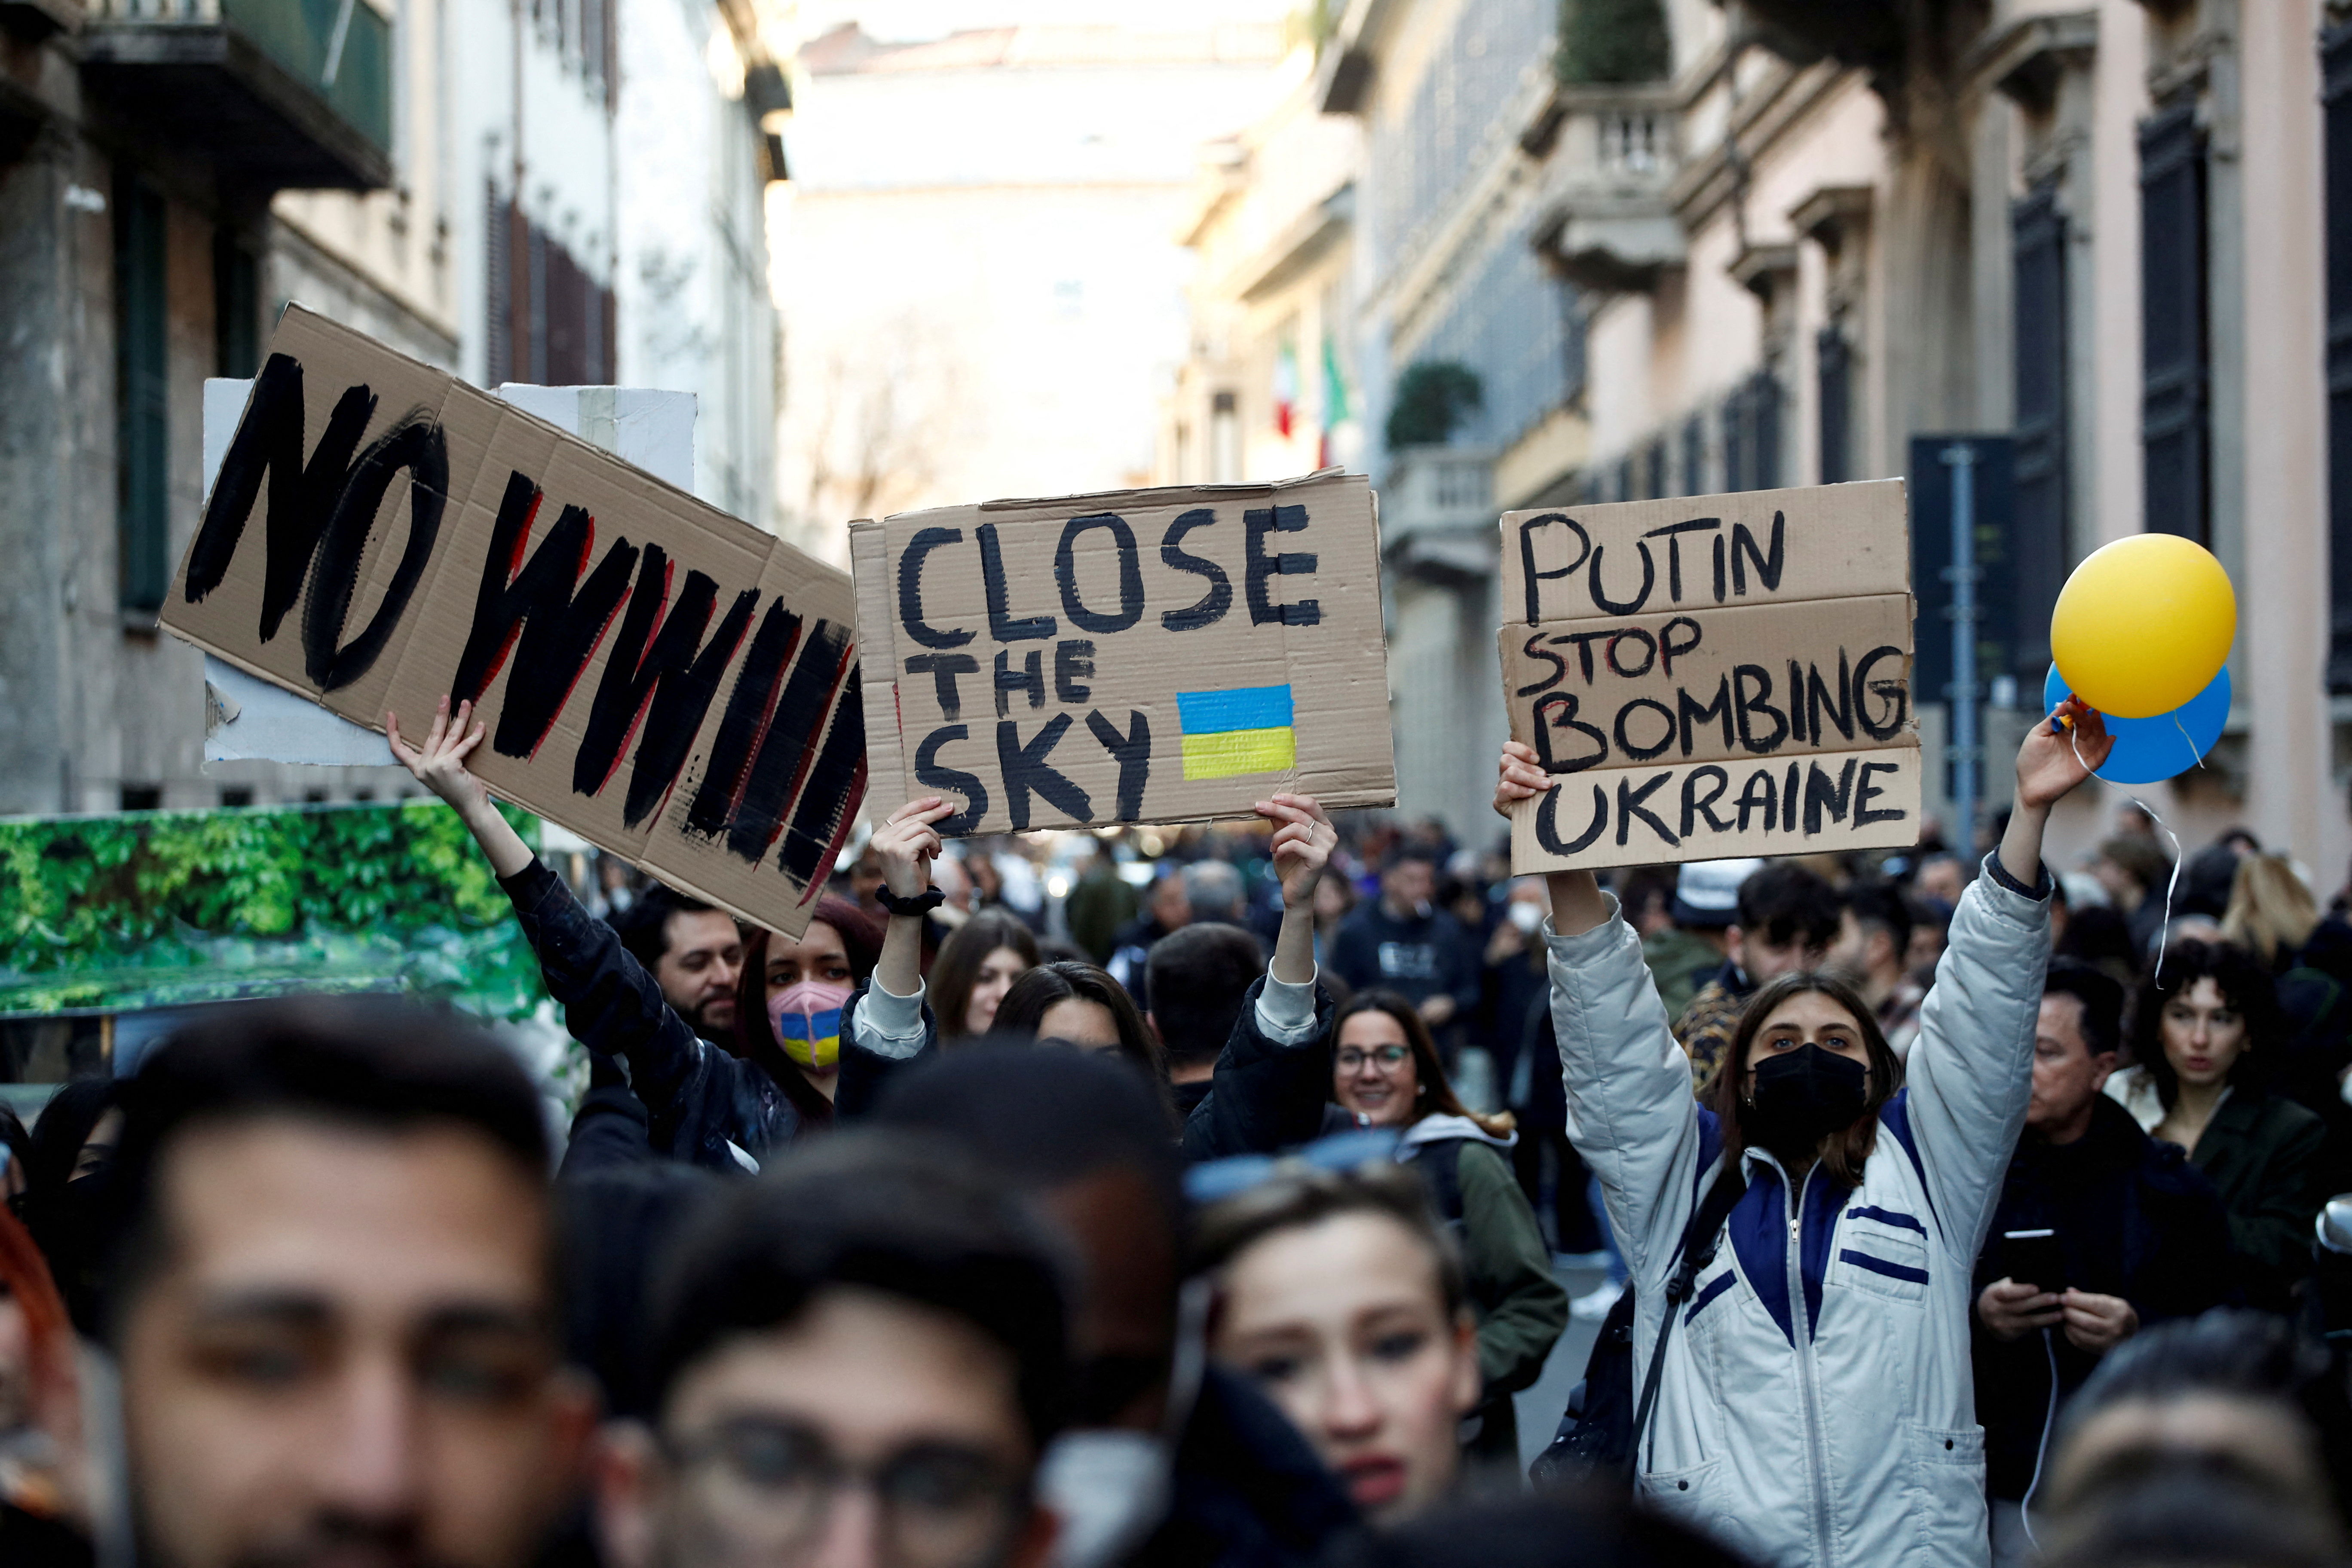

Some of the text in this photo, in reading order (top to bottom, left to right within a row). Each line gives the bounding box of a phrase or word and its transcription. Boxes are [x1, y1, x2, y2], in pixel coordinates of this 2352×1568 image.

[898, 504, 1320, 649] CLOSE
[1520, 510, 1784, 627] PUTIN
[185, 352, 868, 908] NO WWIII
[903, 639, 1095, 723] THE
[1517, 616, 1702, 697] STOP
[1533, 646, 1906, 774] BOMBING
[914, 708, 1151, 836] SKY
[1536, 757, 1906, 857] UKRAINE
